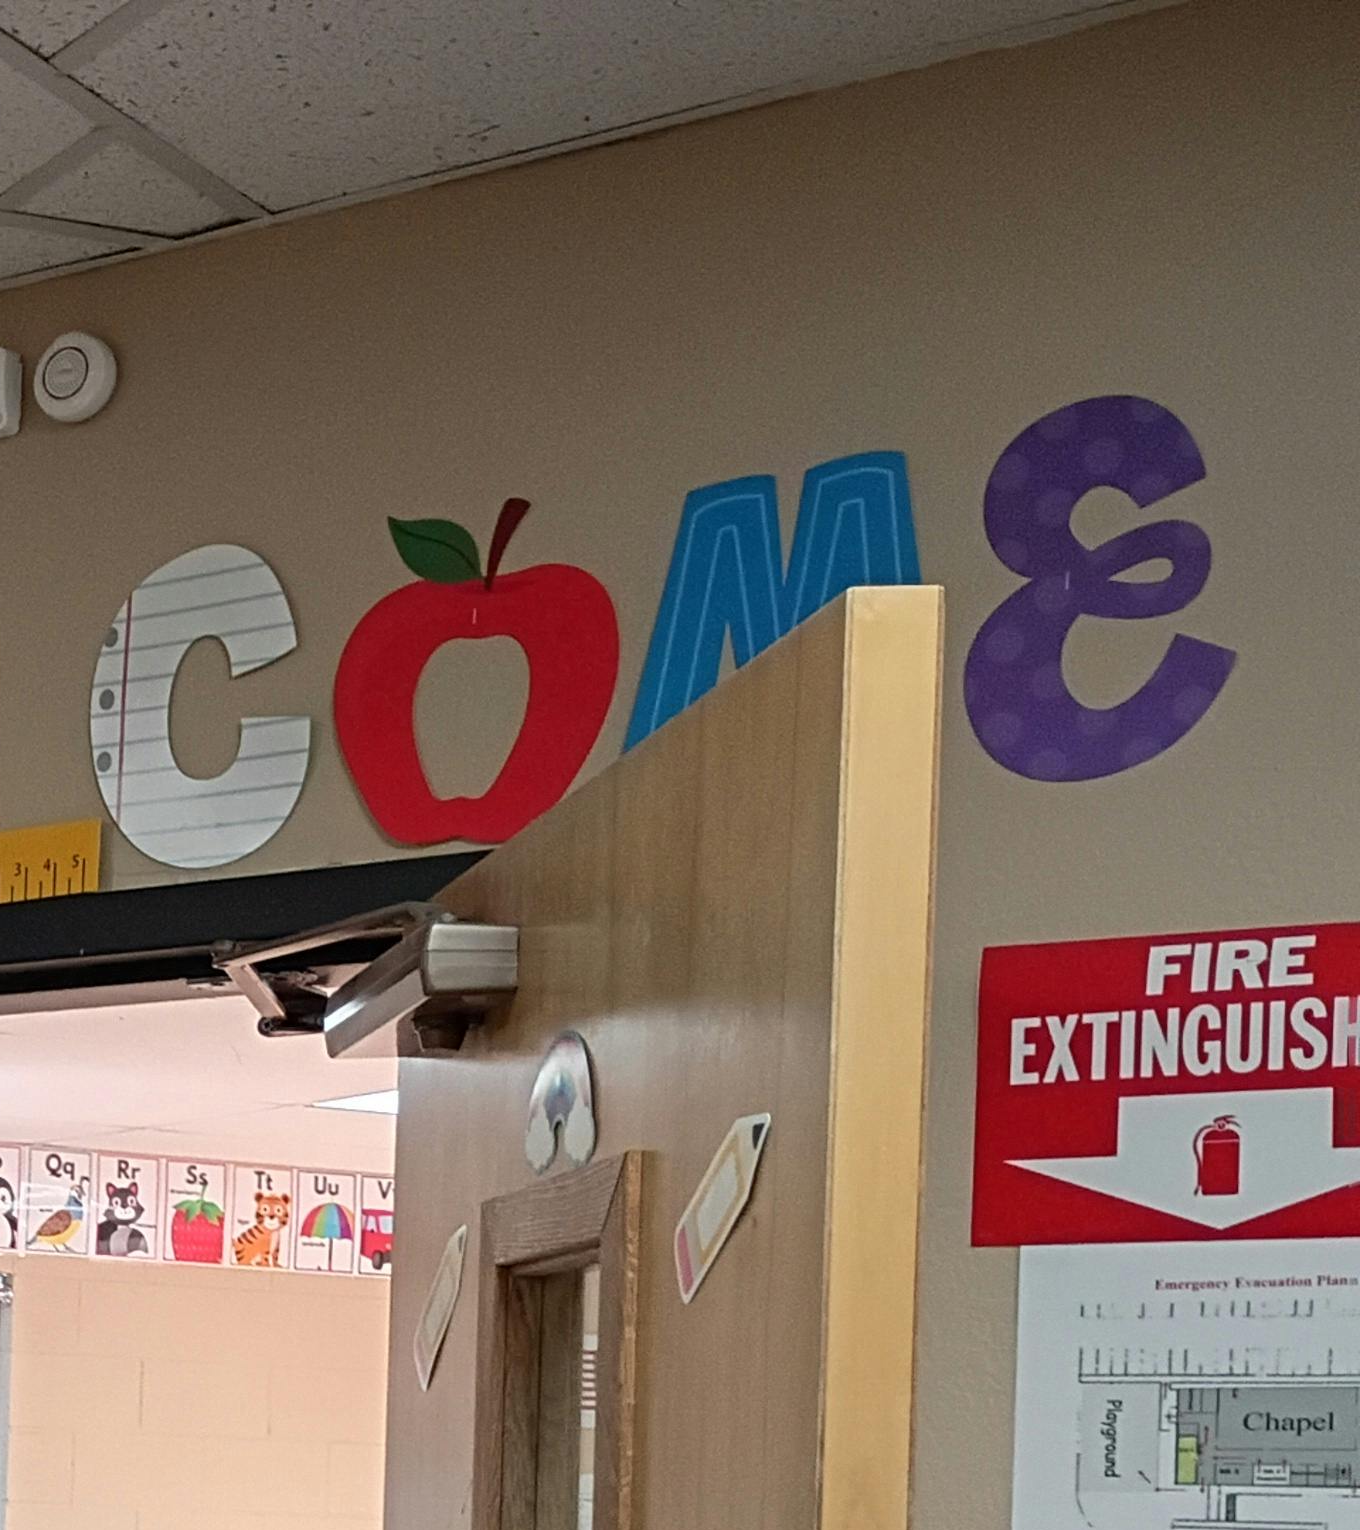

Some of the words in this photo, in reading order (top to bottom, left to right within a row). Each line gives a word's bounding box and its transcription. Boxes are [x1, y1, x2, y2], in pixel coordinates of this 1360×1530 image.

[14, 862, 22, 876] 3
[42, 859, 51, 872] 4
[72, 854, 80, 868] 5
[1146, 934, 1317, 996] FIRE
[45, 1153, 75, 1182] Qq
[117, 1160, 141, 1180] Rr
[186, 1165, 208, 1187] Ss
[254, 1171, 273, 1192] Tt
[314, 1176, 340, 1197] Uu
[378, 1180, 395, 1199] V
[1154, 1277, 1230, 1292] Emergency
[1235, 1275, 1313, 1289] Evacuation
[1242, 1411, 1335, 1437] Chapel
[1100, 1399, 1123, 1478] Playground
